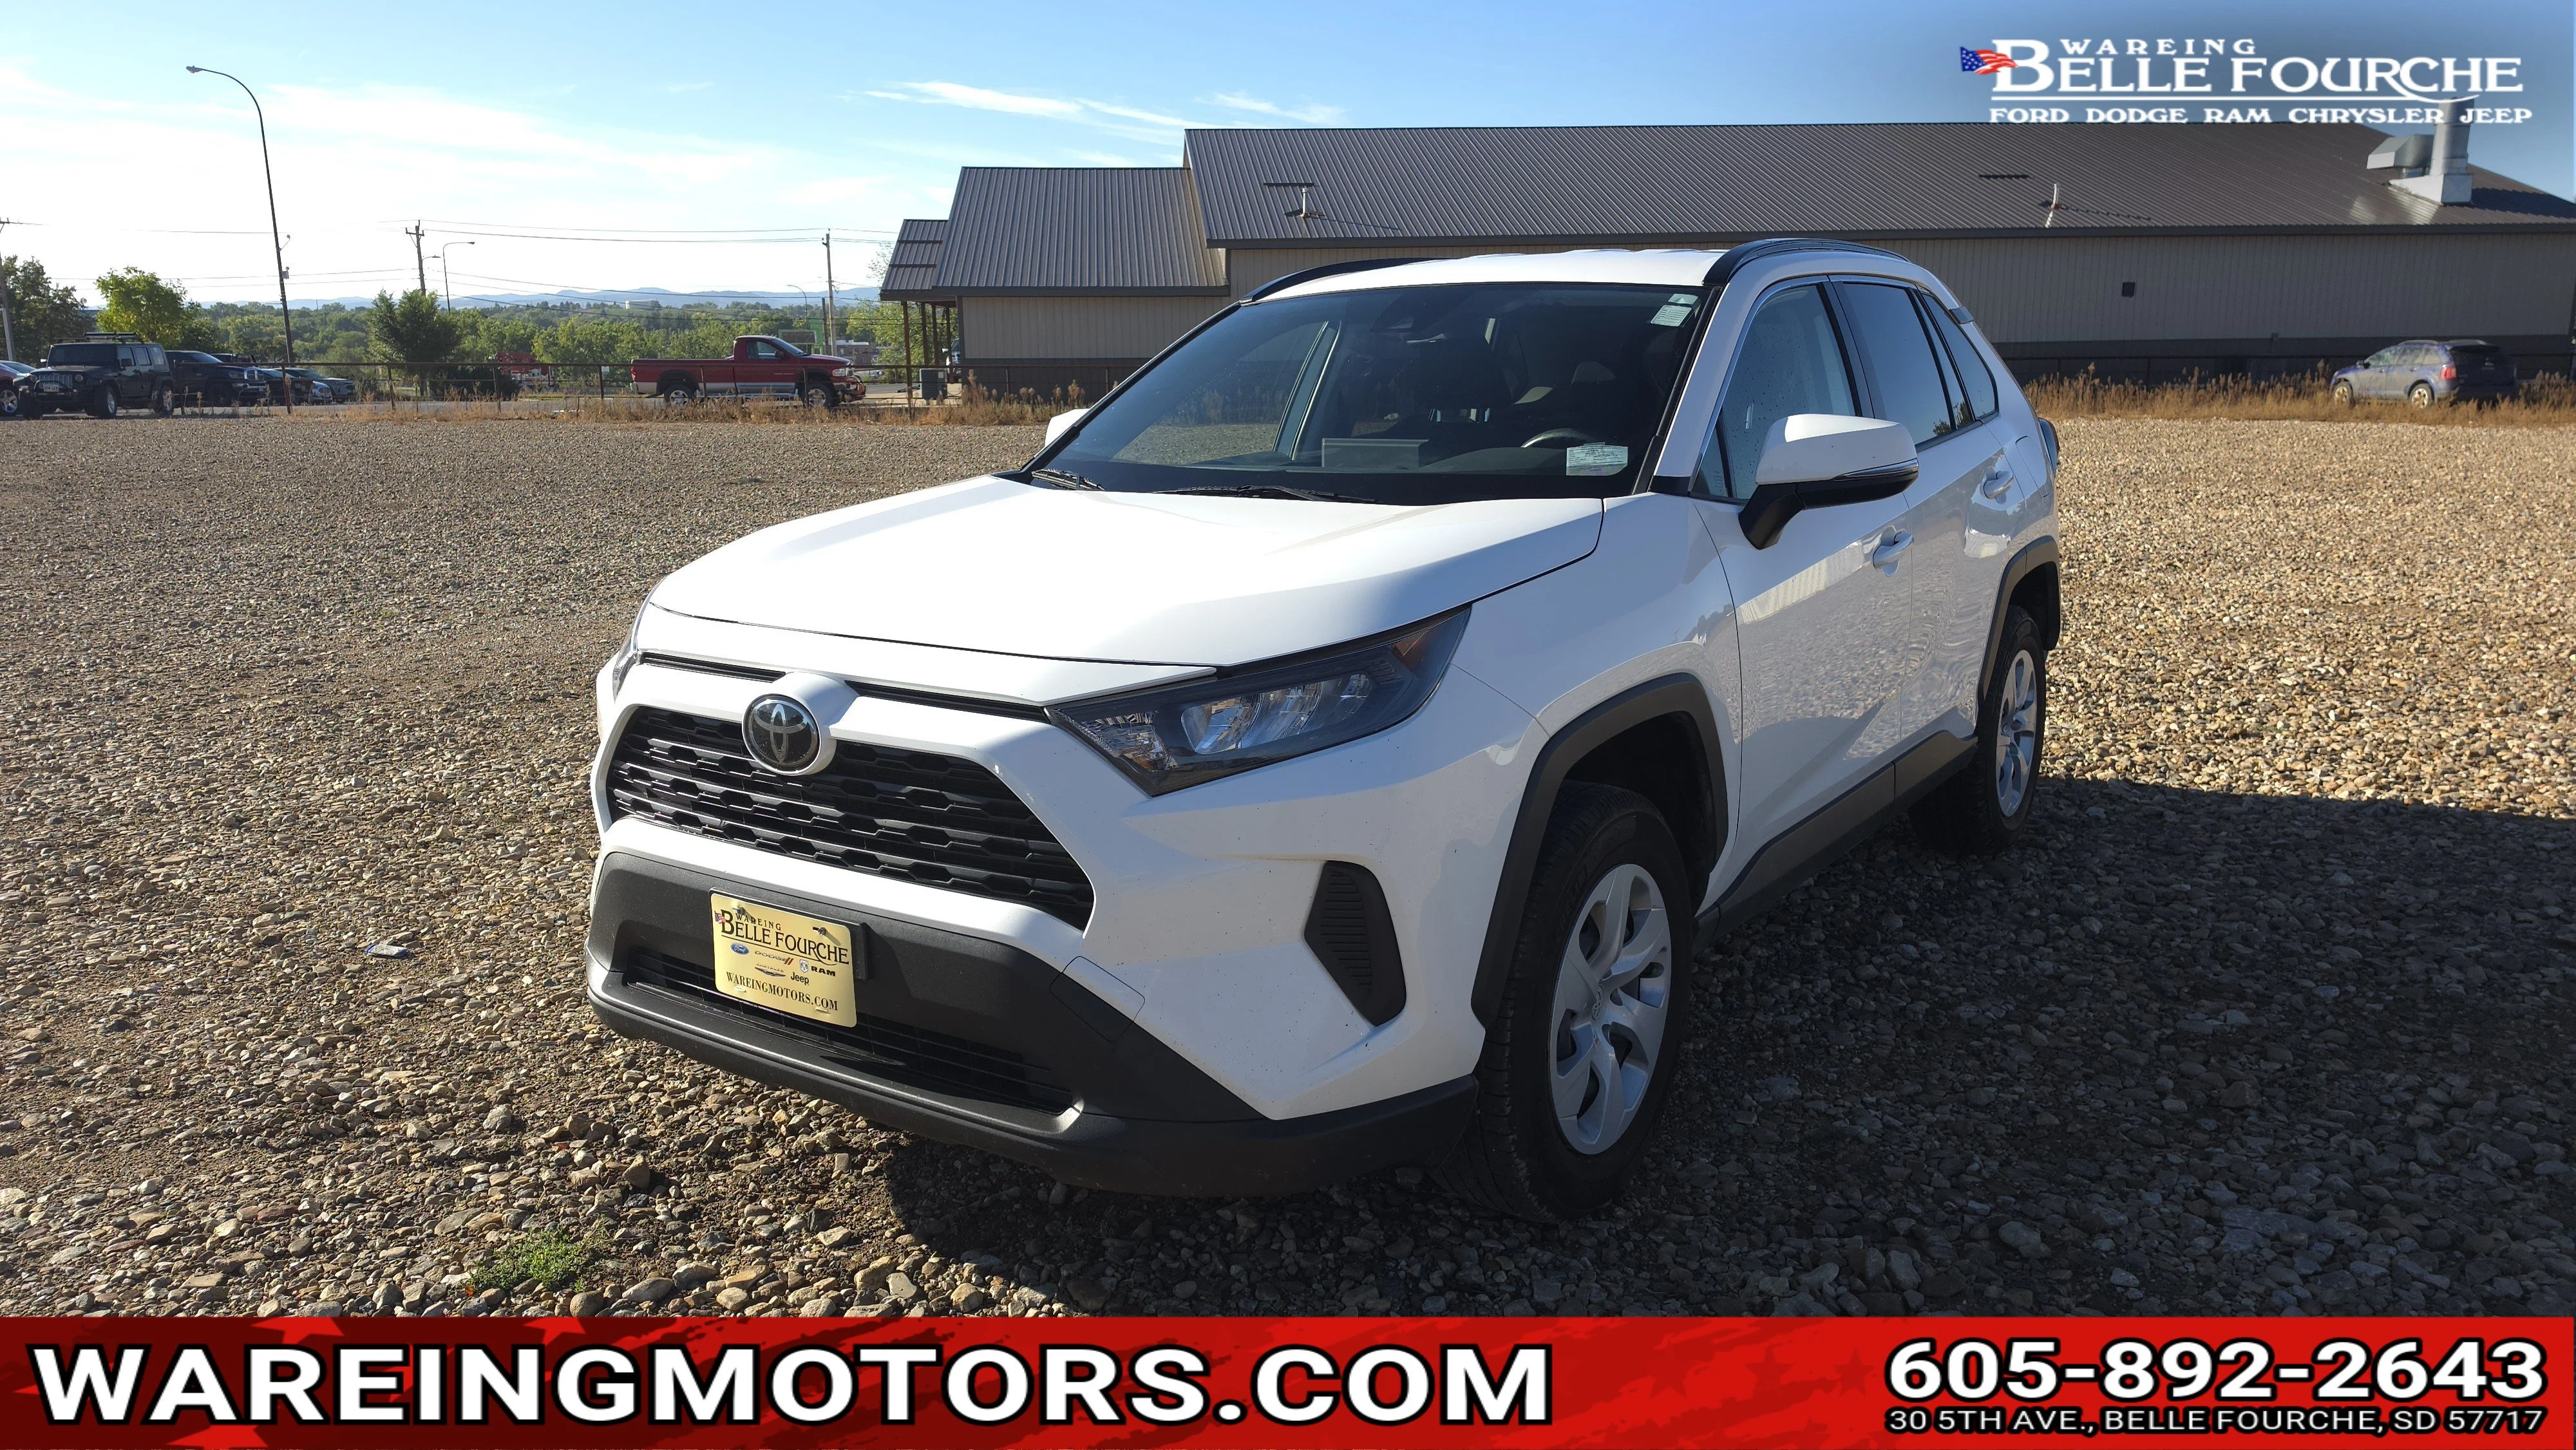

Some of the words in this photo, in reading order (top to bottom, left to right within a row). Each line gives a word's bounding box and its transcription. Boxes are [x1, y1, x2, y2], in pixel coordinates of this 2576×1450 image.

[735, 912, 782, 931] WAREING
[721, 909, 772, 945] BELLE
[775, 930, 849, 965] FOURCHE
[790, 972, 810, 986] Jeep
[811, 965, 836, 977] RAM
[726, 971, 838, 1012] WAREINGMOTORS.COM
